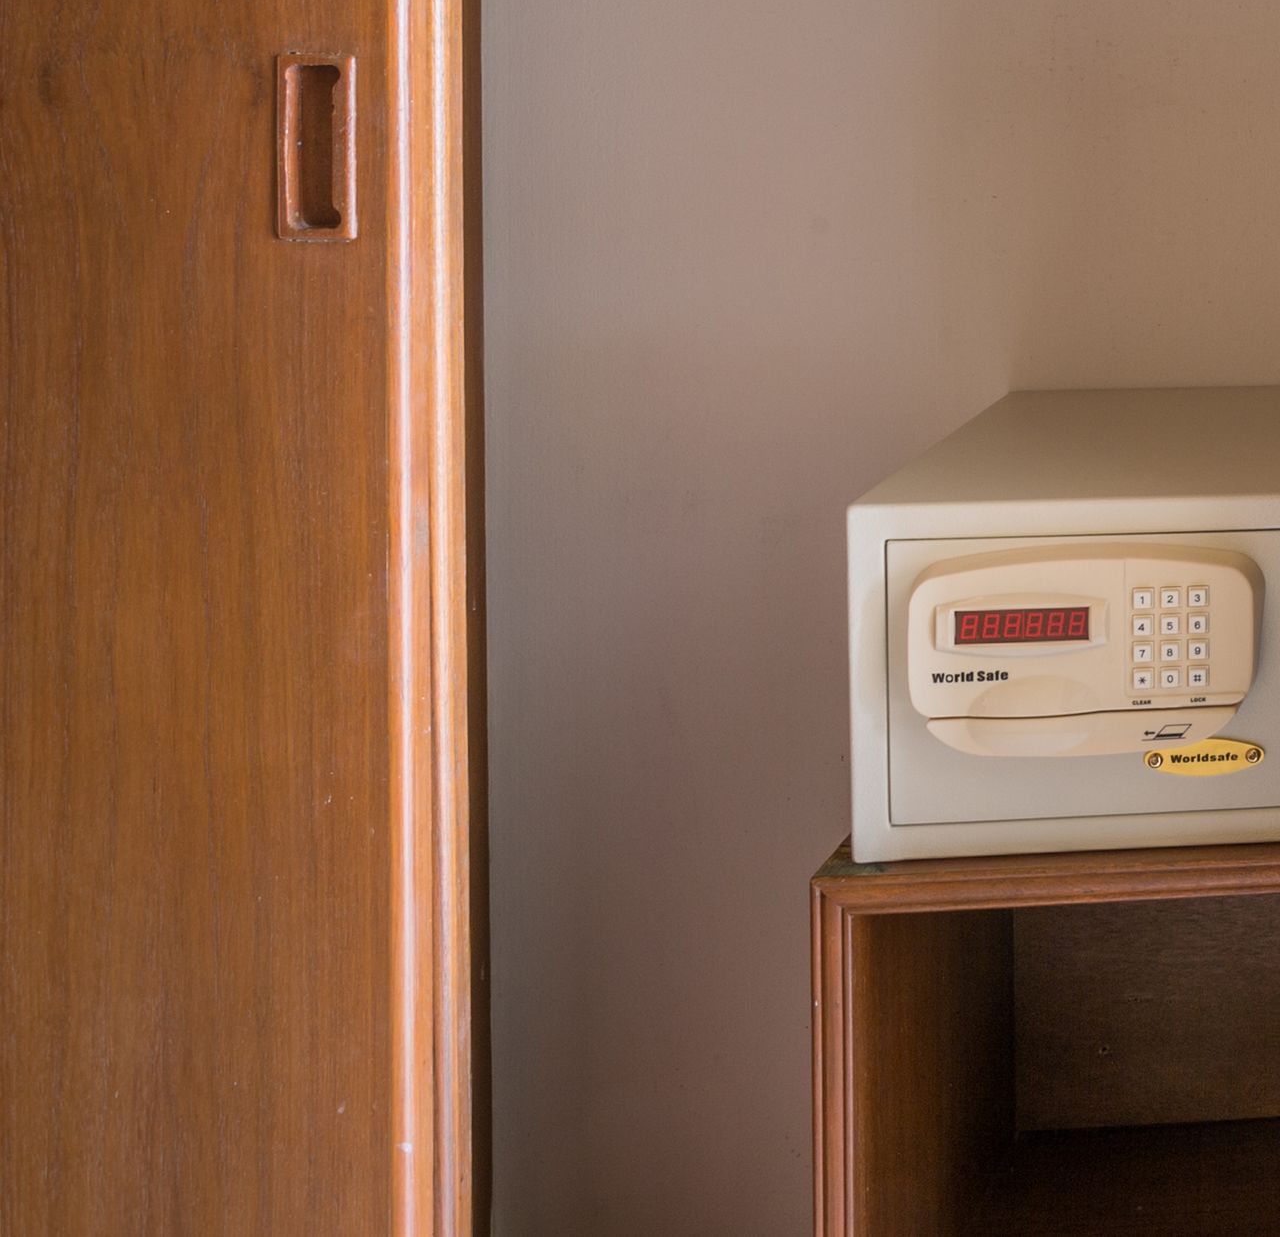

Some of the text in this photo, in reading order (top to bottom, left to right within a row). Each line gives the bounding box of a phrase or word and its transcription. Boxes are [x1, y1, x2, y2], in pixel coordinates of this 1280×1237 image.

[1139, 593, 1201, 605] 1 2 3
[1137, 620, 1201, 632] 4 5 6
[1139, 646, 1201, 658] 7 8 9
[932, 670, 1009, 683] World Safe
[1166, 674, 1174, 684] 0
[1170, 752, 1239, 764] Worldsafe
